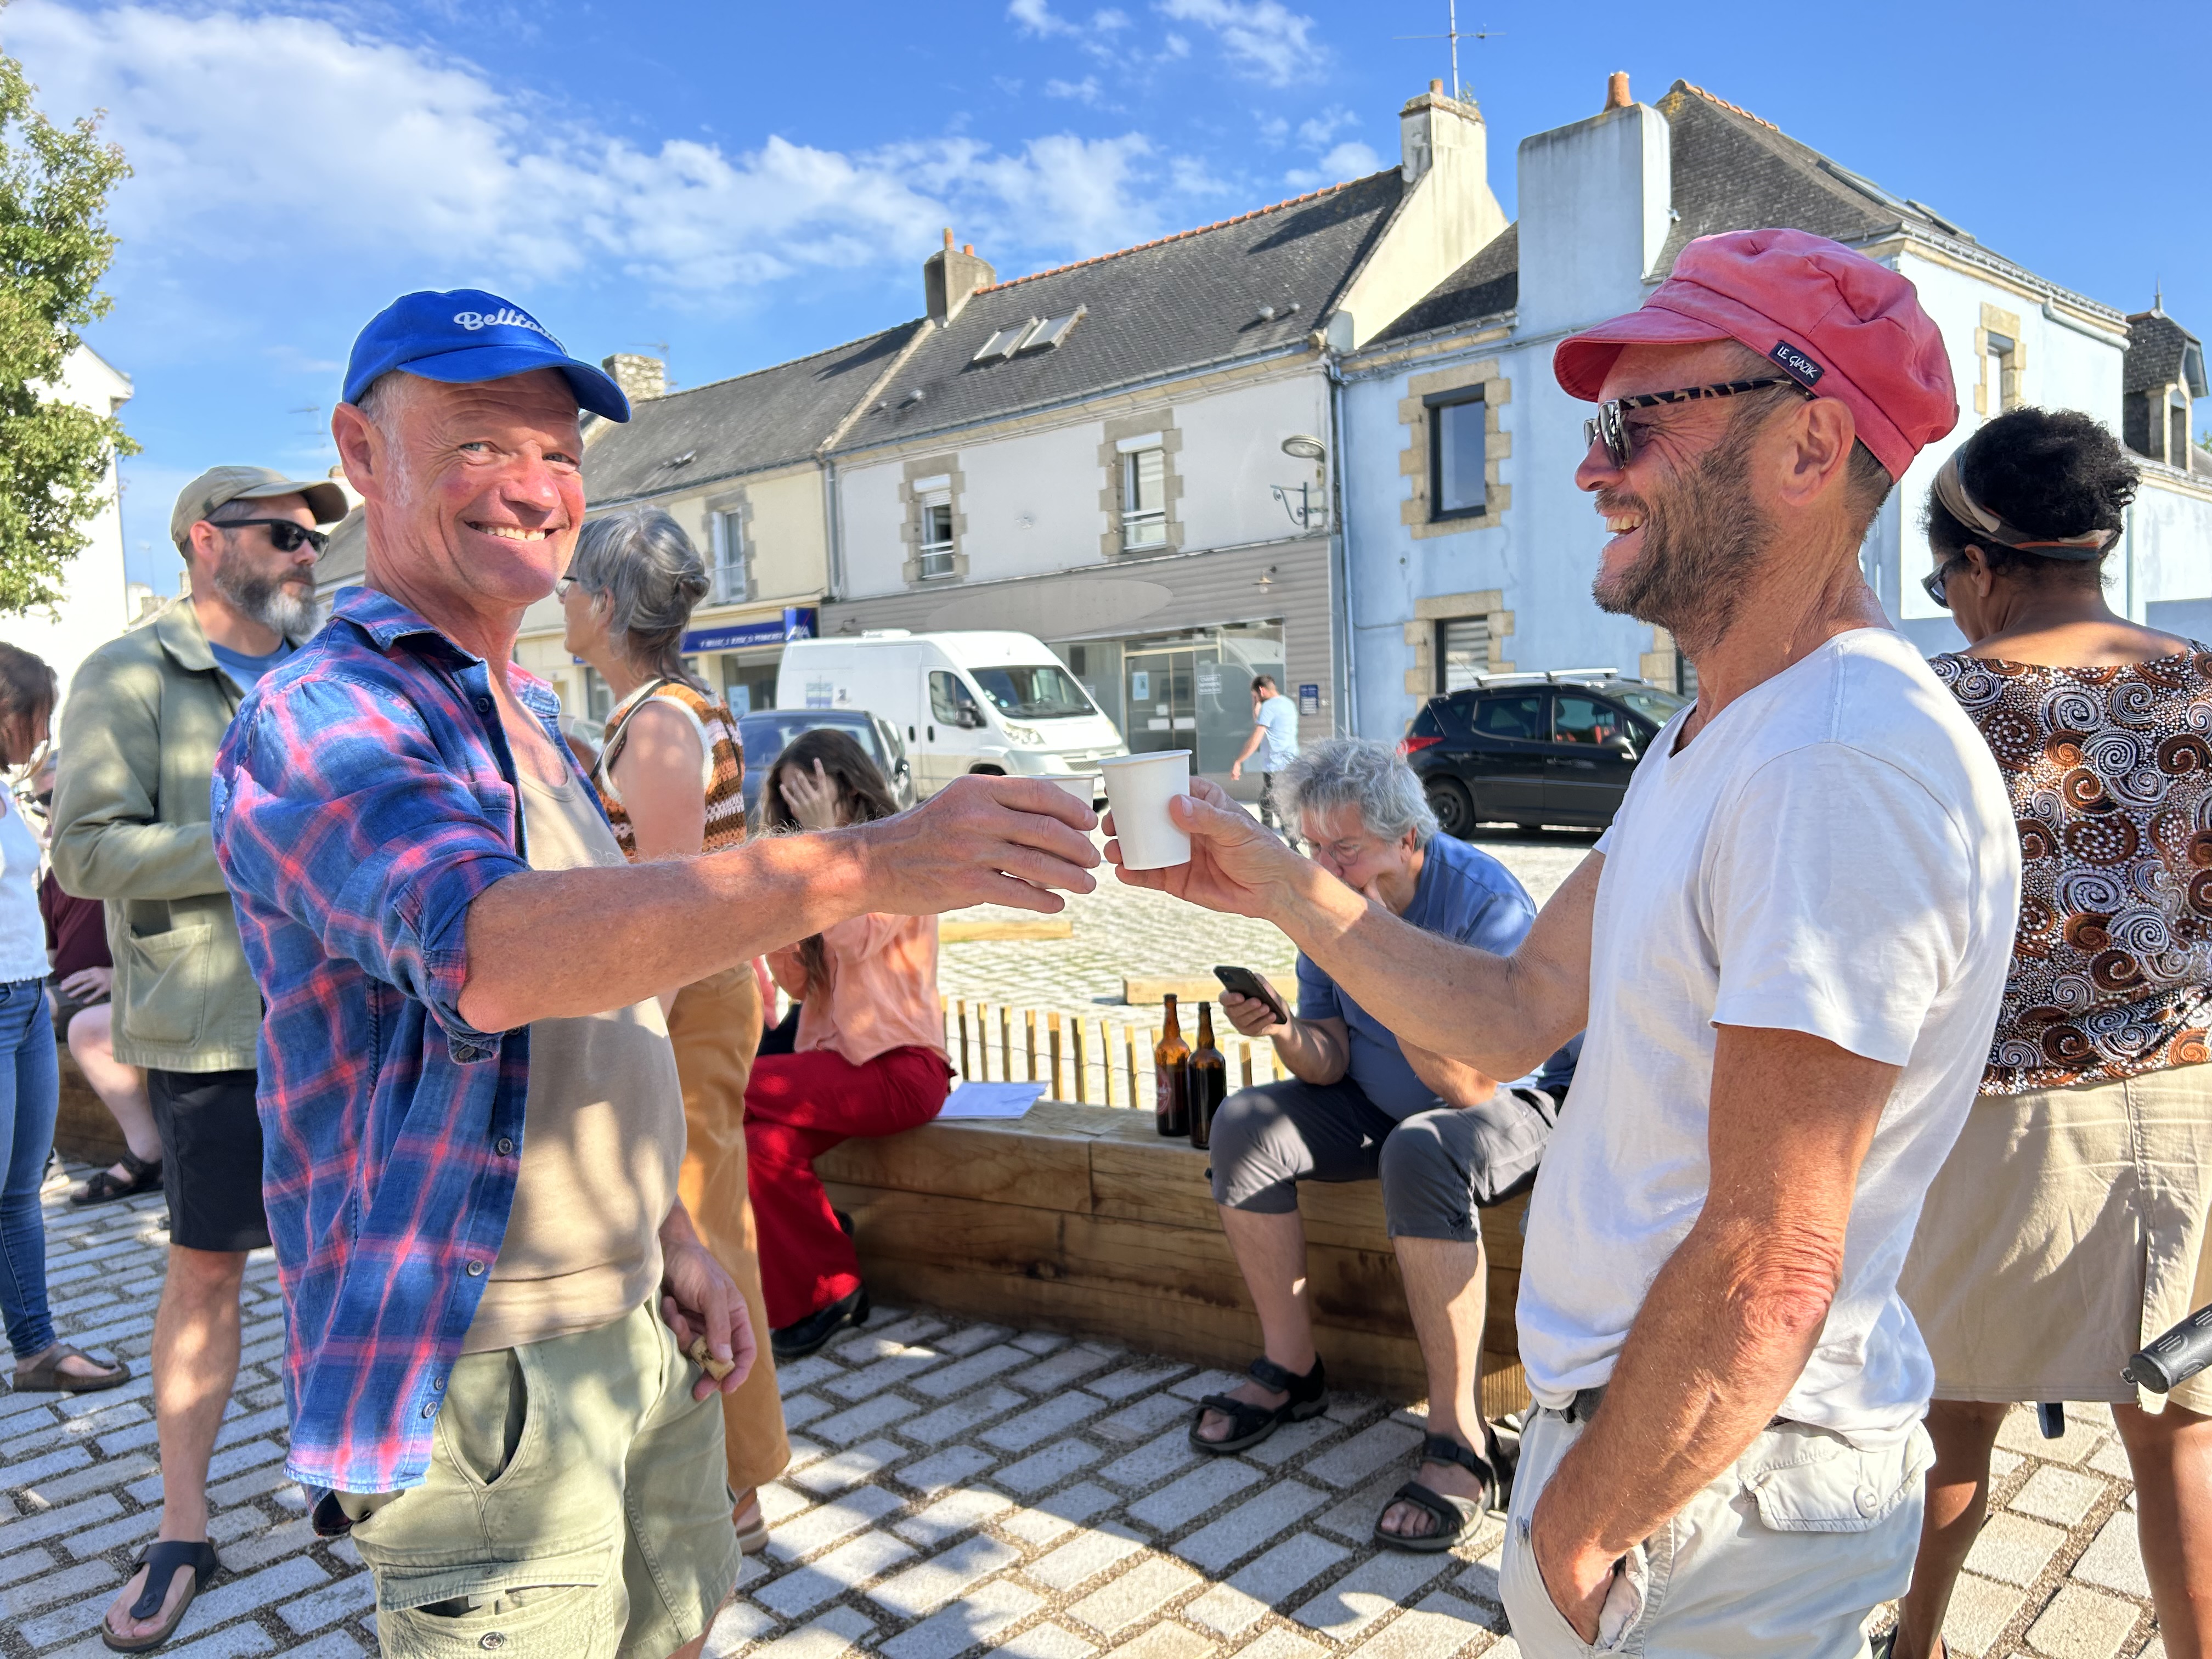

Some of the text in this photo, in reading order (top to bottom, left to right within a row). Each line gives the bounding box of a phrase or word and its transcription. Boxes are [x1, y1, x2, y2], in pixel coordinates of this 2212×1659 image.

[1777, 346, 1818, 379] LE GLAZIK
[785, 624, 811, 641] AXA
